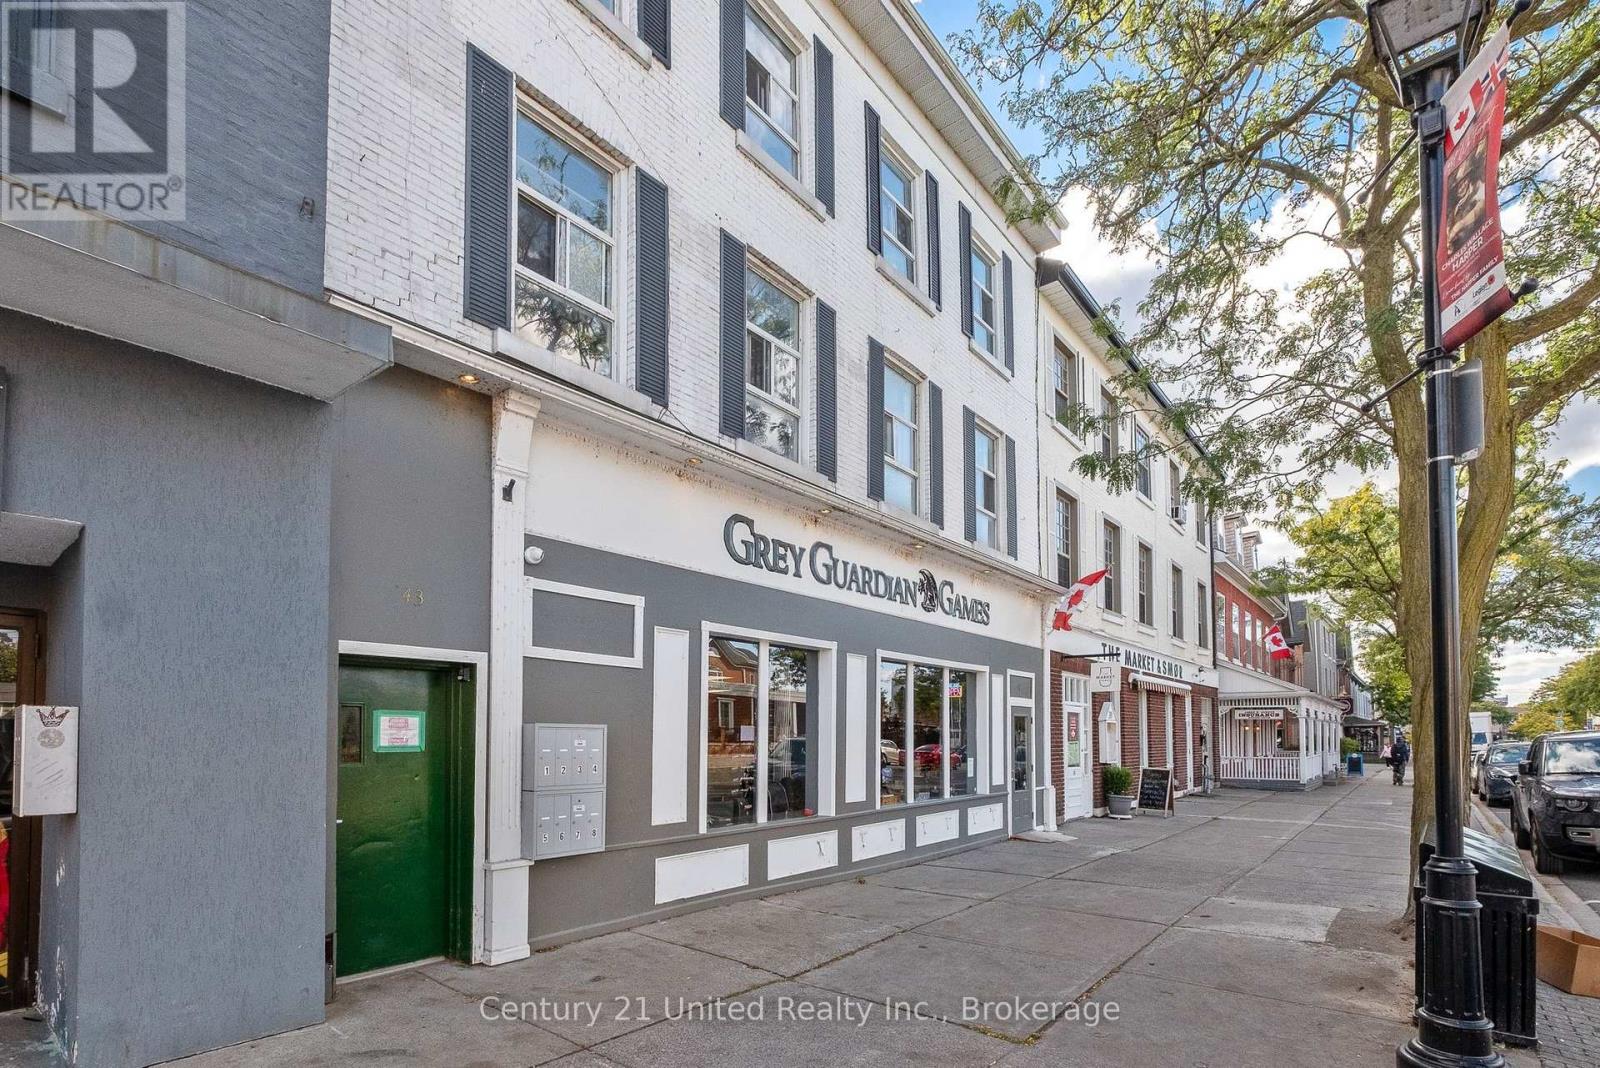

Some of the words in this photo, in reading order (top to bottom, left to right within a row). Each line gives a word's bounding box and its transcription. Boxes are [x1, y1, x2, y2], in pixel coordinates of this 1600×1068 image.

[1452, 236, 1484, 272] HARPER
[1101, 642, 1121, 663] THE
[1124, 649, 1155, 673] MARKET
